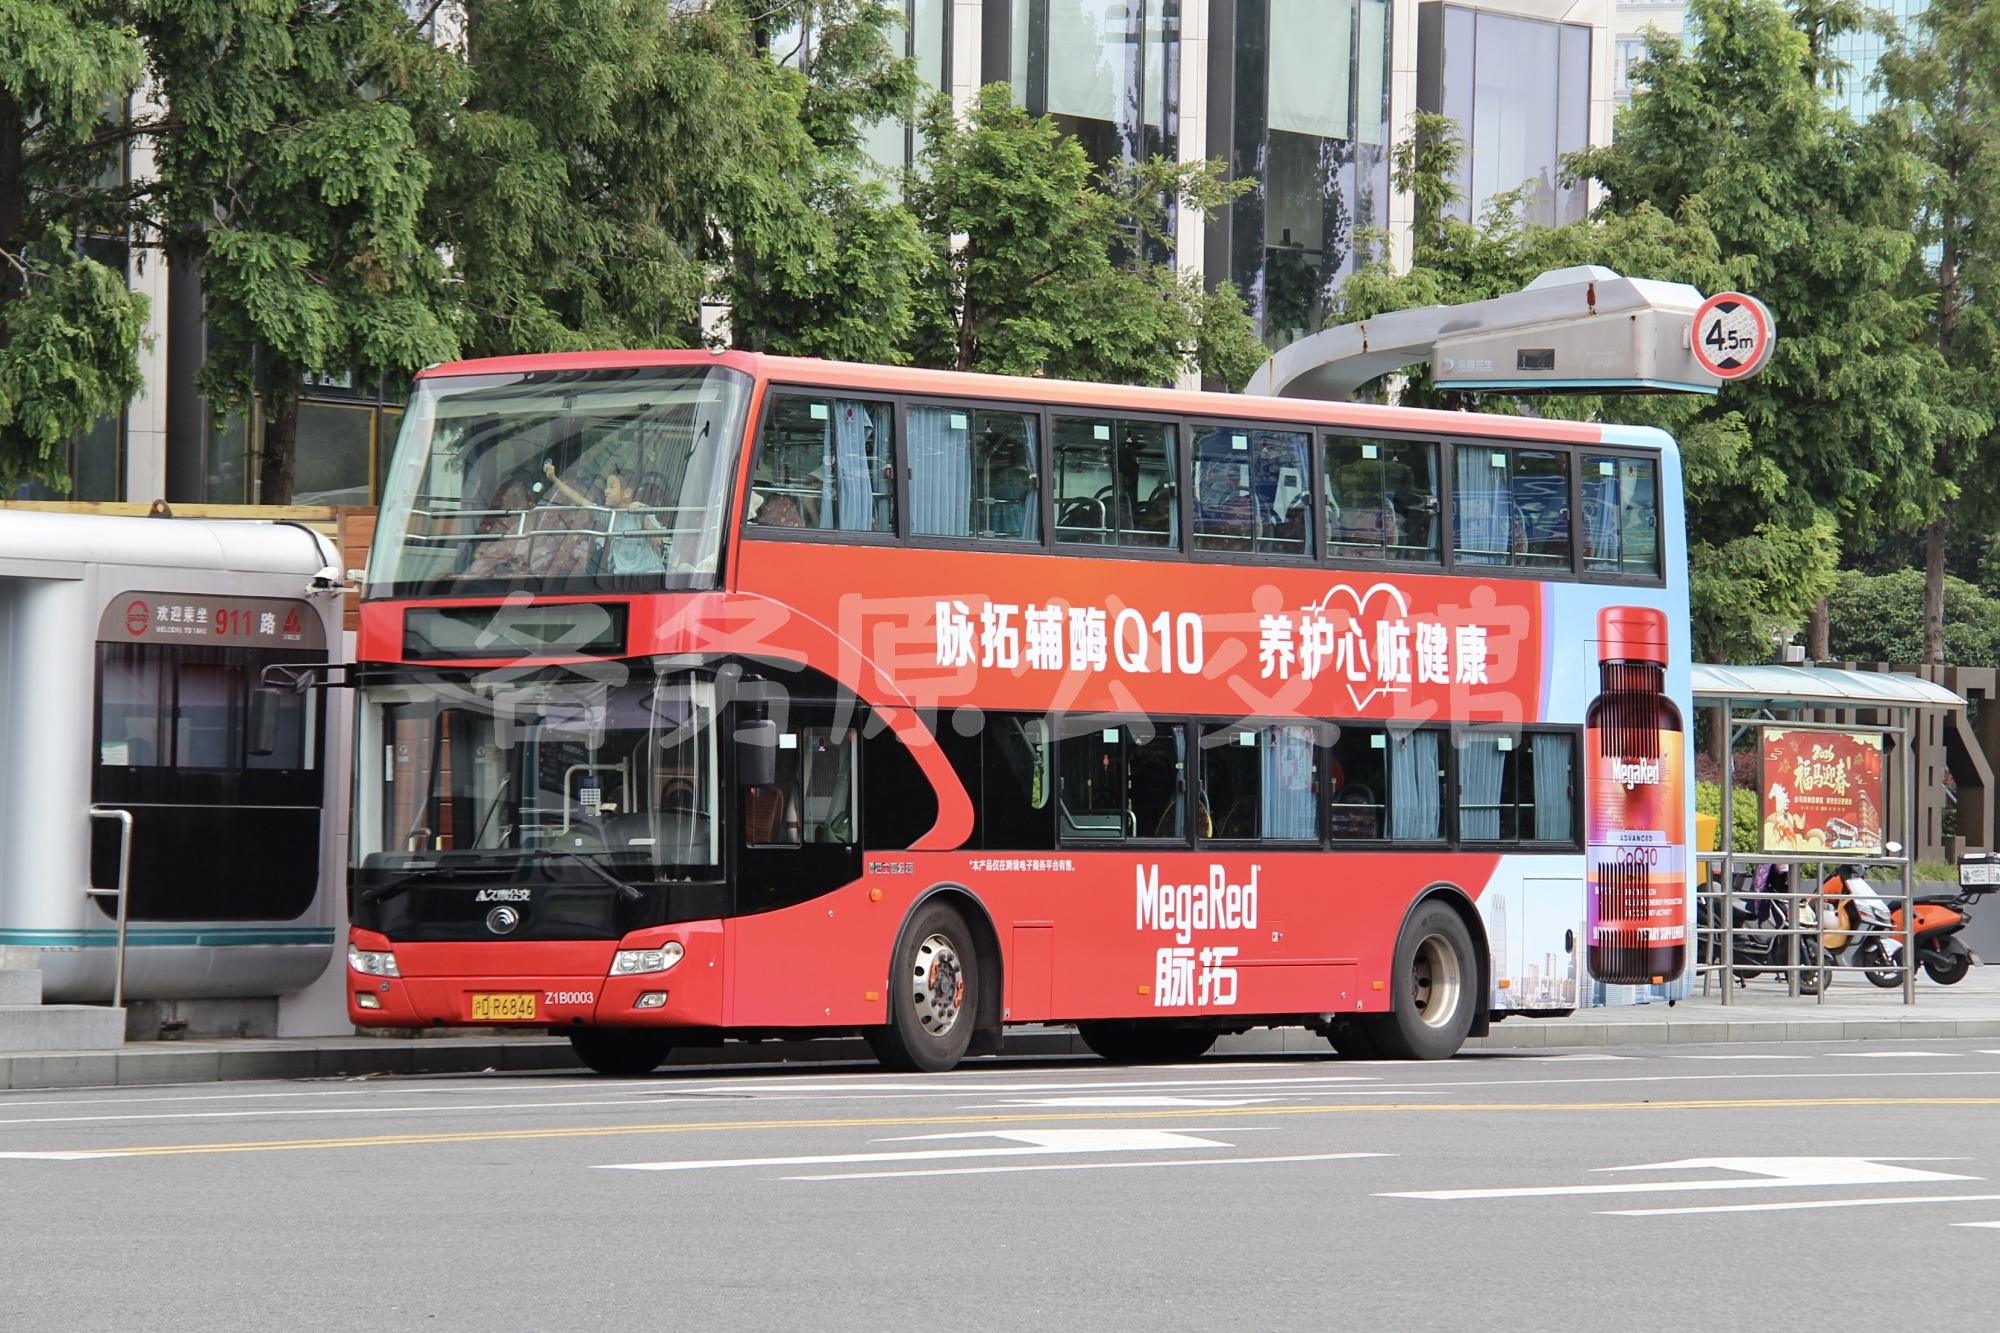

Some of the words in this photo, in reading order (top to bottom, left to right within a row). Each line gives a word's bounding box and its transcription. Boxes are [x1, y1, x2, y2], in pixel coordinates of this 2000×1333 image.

[1706, 319, 1753, 351] 4.5m
[156, 606, 208, 623] 欢迎乘坐
[215, 608, 254, 636] 911
[260, 612, 276, 635] 路
[936, 600, 1204, 674] 脉拓辅酶Q10
[1259, 614, 1488, 685] 养护心脏健康
[1612, 757, 1659, 790] MegaRed
[1793, 755, 1851, 796] 福马迎春
[1616, 846, 1657, 867] CoQ10
[1154, 947, 1238, 1006] 脉拓
[545, 992, 594, 1004] Z1B0003
